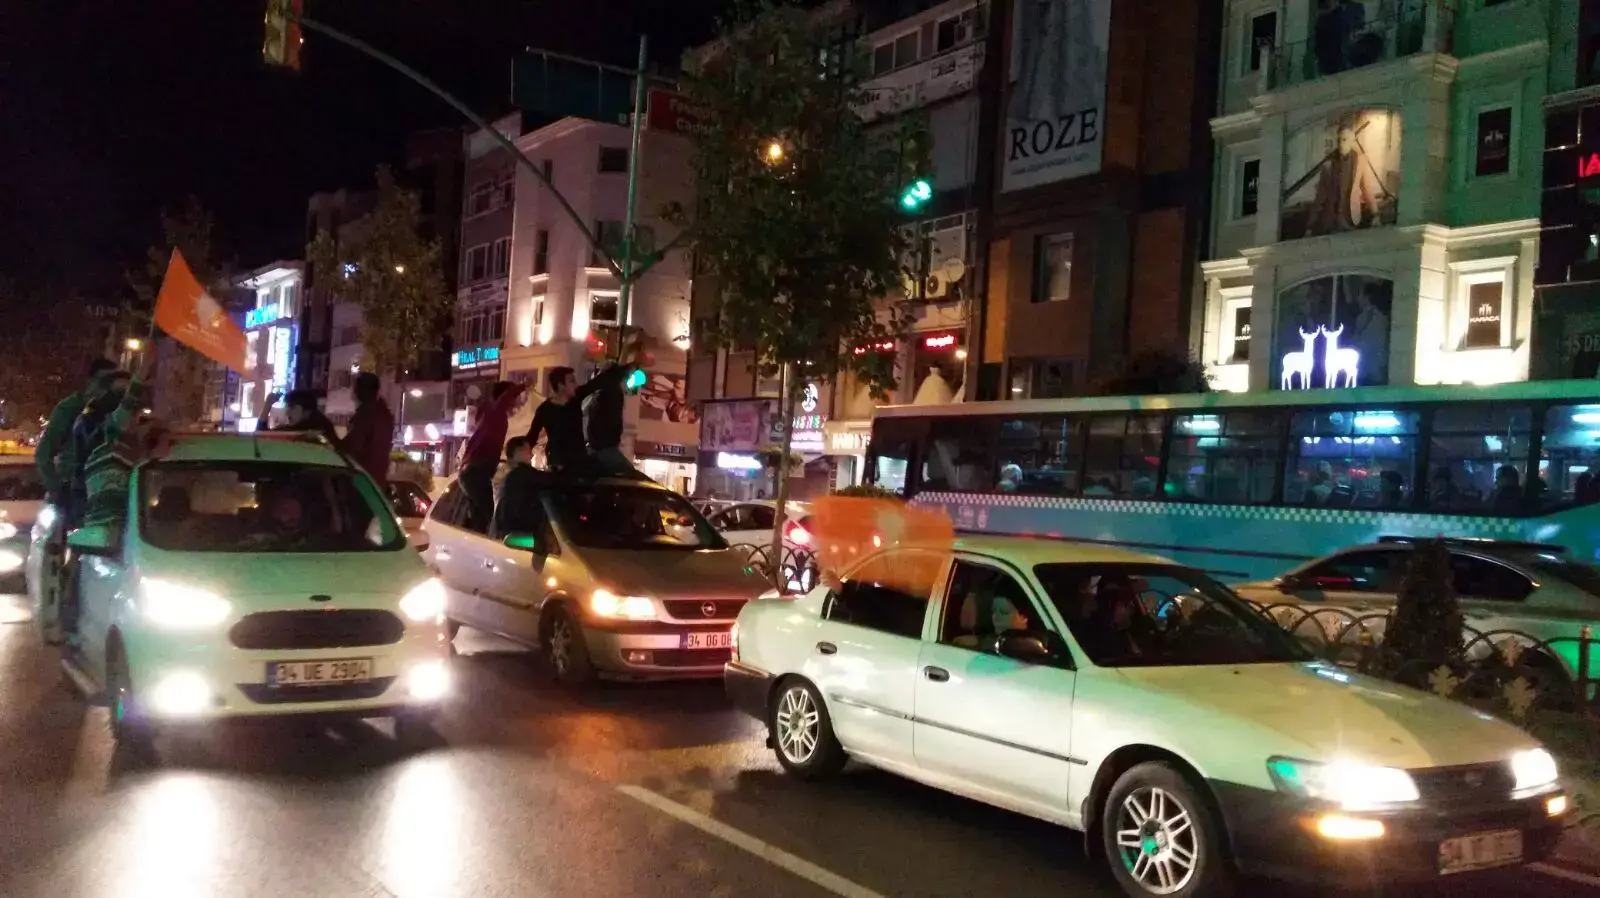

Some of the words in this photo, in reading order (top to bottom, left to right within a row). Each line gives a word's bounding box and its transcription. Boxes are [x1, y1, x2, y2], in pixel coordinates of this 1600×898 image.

[1009, 107, 1098, 162] ROZE
[1469, 315, 1500, 323] KARACA
[688, 634, 700, 647] 34
[277, 664, 298, 681] 34
